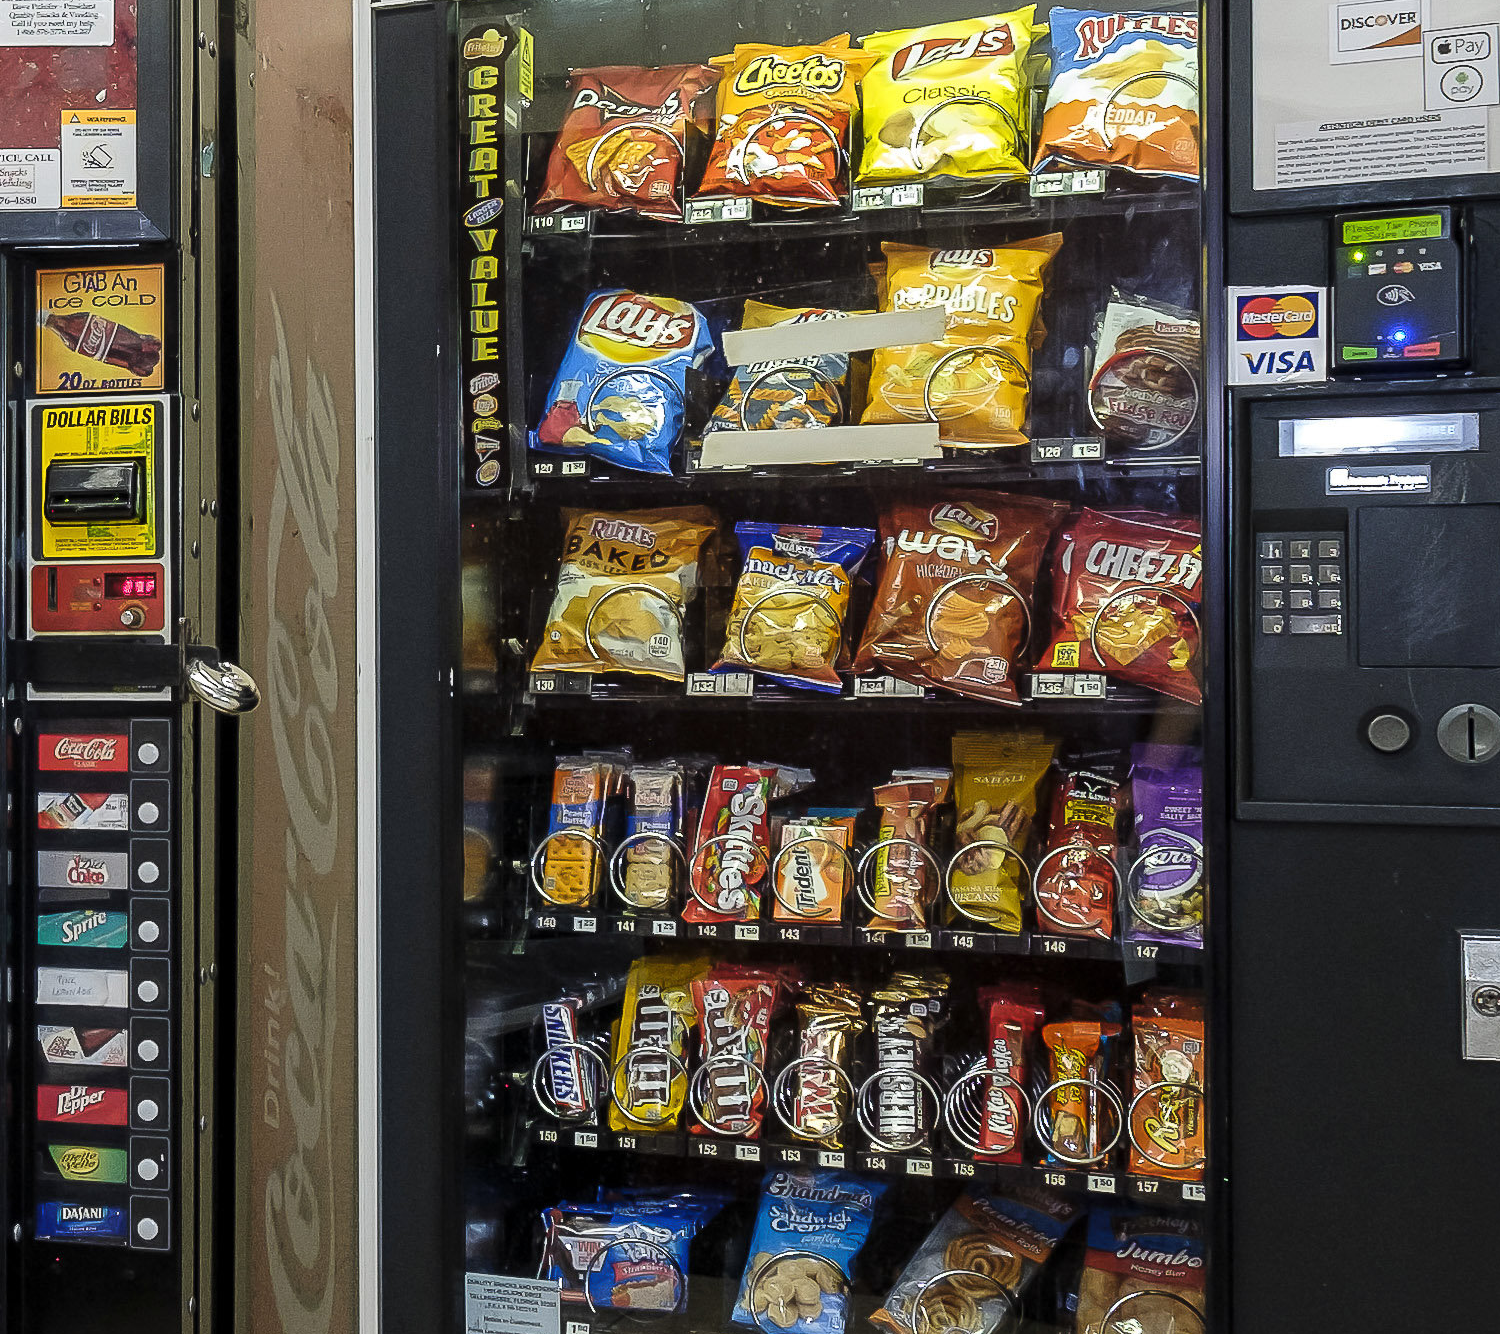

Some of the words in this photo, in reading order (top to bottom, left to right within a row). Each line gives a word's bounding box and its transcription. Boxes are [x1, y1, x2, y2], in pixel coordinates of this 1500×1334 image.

[1341, 12, 1416, 30] DISCOVER
[1076, 16, 1198, 59] RUFFLES
[1455, 38, 1484, 55] Pay
[733, 54, 845, 96] Cheetos
[903, 84, 991, 104] Classic
[468, 66, 499, 199] GREAT
[25, 154, 55, 162] CALL
[0, 168, 28, 177] Snacks
[534, 216, 554, 229] 110
[1345, 224, 1380, 235] Please
[1403, 228, 1428, 237] Card
[112, 273, 138, 292] An
[92, 294, 156, 307] COLD
[469, 229, 499, 362] VALUE
[1241, 309, 1313, 325] MasterCard
[1240, 350, 1315, 375] VISA
[58, 371, 83, 391] 20
[46, 409, 107, 429] DOLLAR
[109, 407, 152, 426] BILLS
[535, 463, 553, 473] 120
[591, 518, 658, 548] RUFFLES
[566, 535, 670, 571] BAKED
[916, 562, 964, 579] HICKORY
[1312, 624, 1338, 632] C/CE
[653, 636, 668, 645] 140
[535, 679, 554, 691] 130
[54, 737, 118, 761] Coca-Cola
[718, 793, 766, 911] Skittles
[796, 845, 819, 912] Trident
[62, 910, 108, 944] Sprite
[537, 918, 557, 927] 140
[616, 922, 635, 931] 141
[698, 926, 717, 936] 142
[780, 929, 800, 940] 143
[952, 937, 973, 947] 145
[1044, 941, 1066, 952] 146
[1136, 946, 1158, 958] 147
[260, 961, 282, 1133] Drink!
[544, 1004, 580, 1104] SNICKERS
[70, 1086, 88, 1097] Dr
[57, 1090, 106, 1115] Pepper
[539, 1131, 557, 1142] 150
[618, 1137, 635, 1148] 151
[698, 1144, 717, 1155] 152
[866, 1158, 886, 1170] 154
[768, 1171, 873, 1212] Grandma's
[1137, 1180, 1158, 1193] 157
[62, 1207, 102, 1221] DASANI
[769, 1205, 852, 1228] Sandwich
[1116, 1241, 1203, 1269] Jumbo
